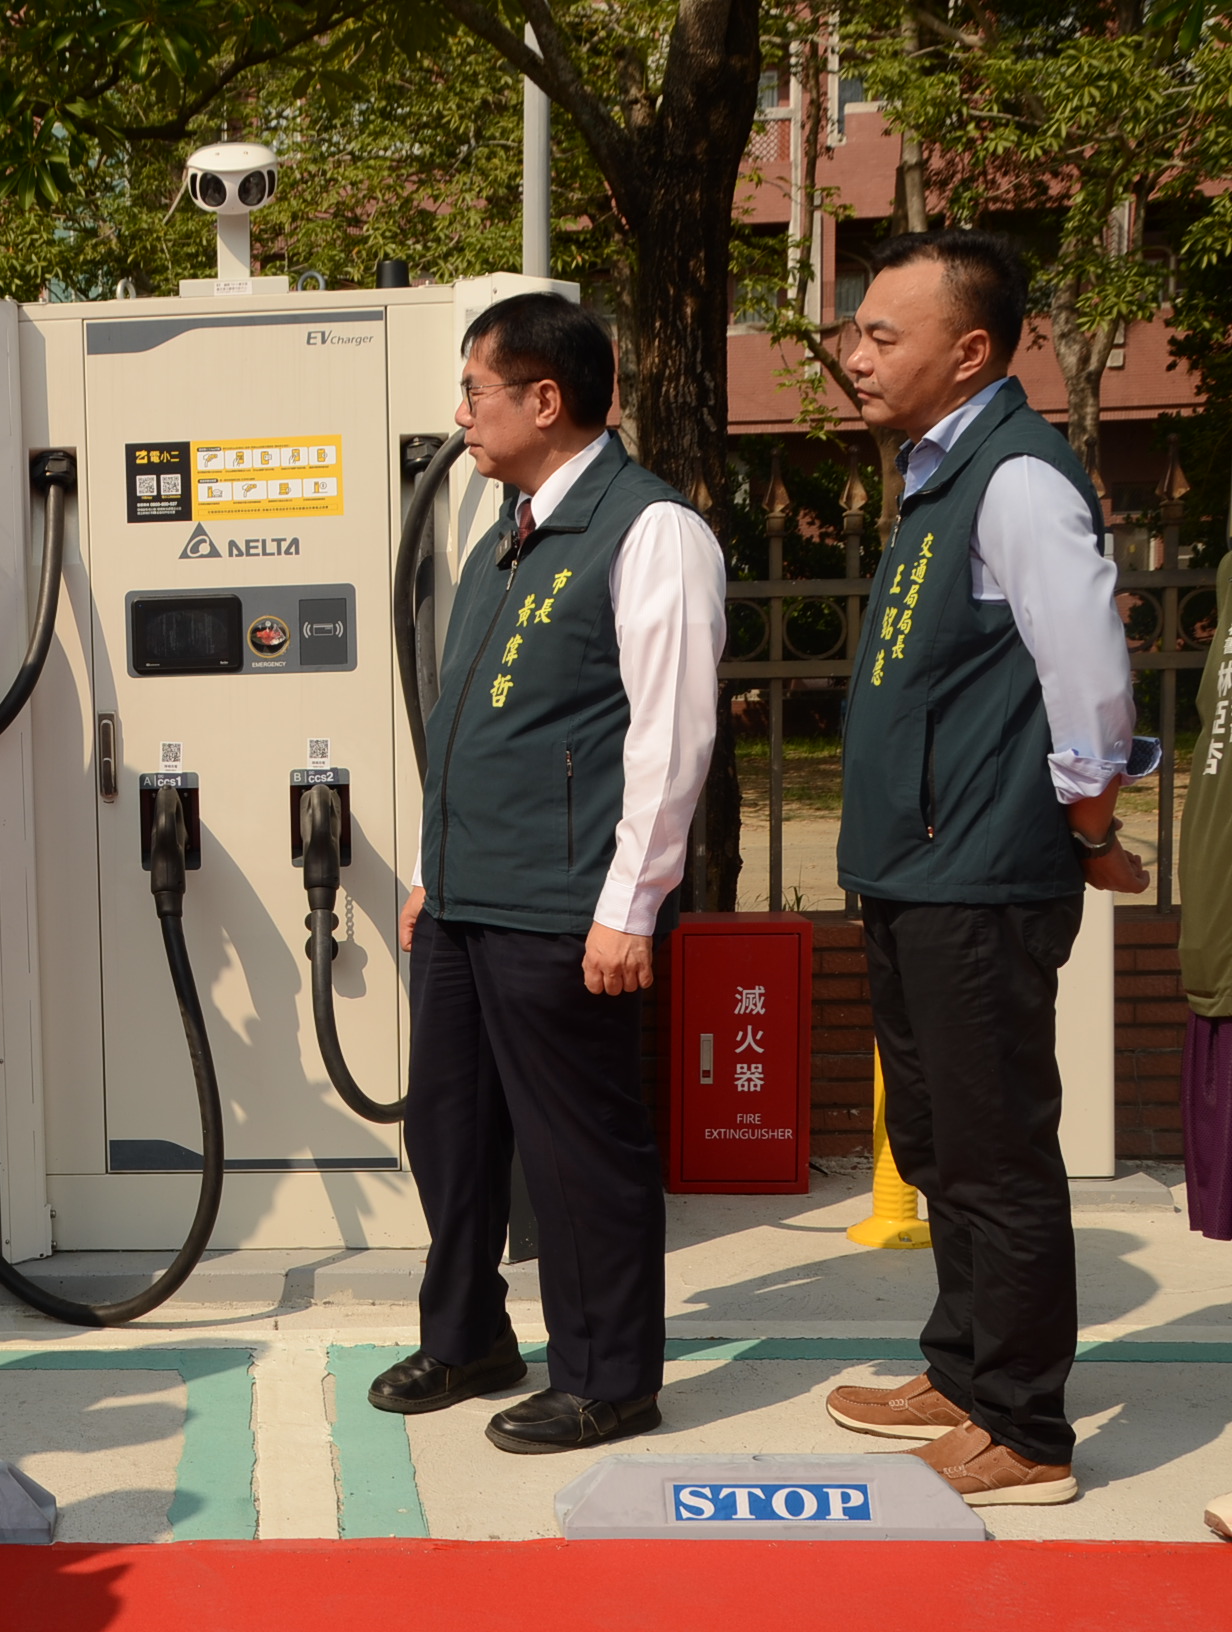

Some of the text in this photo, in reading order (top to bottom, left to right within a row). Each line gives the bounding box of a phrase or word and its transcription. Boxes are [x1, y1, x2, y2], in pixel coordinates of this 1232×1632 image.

[149, 450, 180, 464] 電小二
[228, 537, 300, 558] DELTA
[533, 568, 572, 624] 市長
[891, 533, 935, 660] 交通局局長
[490, 593, 536, 708] 黃偉哲
[143, 776, 152, 786] A
[293, 772, 302, 782] B
[734, 985, 766, 1092] 滅火器
[737, 1113, 762, 1125] FIRE
[704, 1128, 793, 1141] EXTINGUISHER
[679, 1487, 865, 1520] STOP
